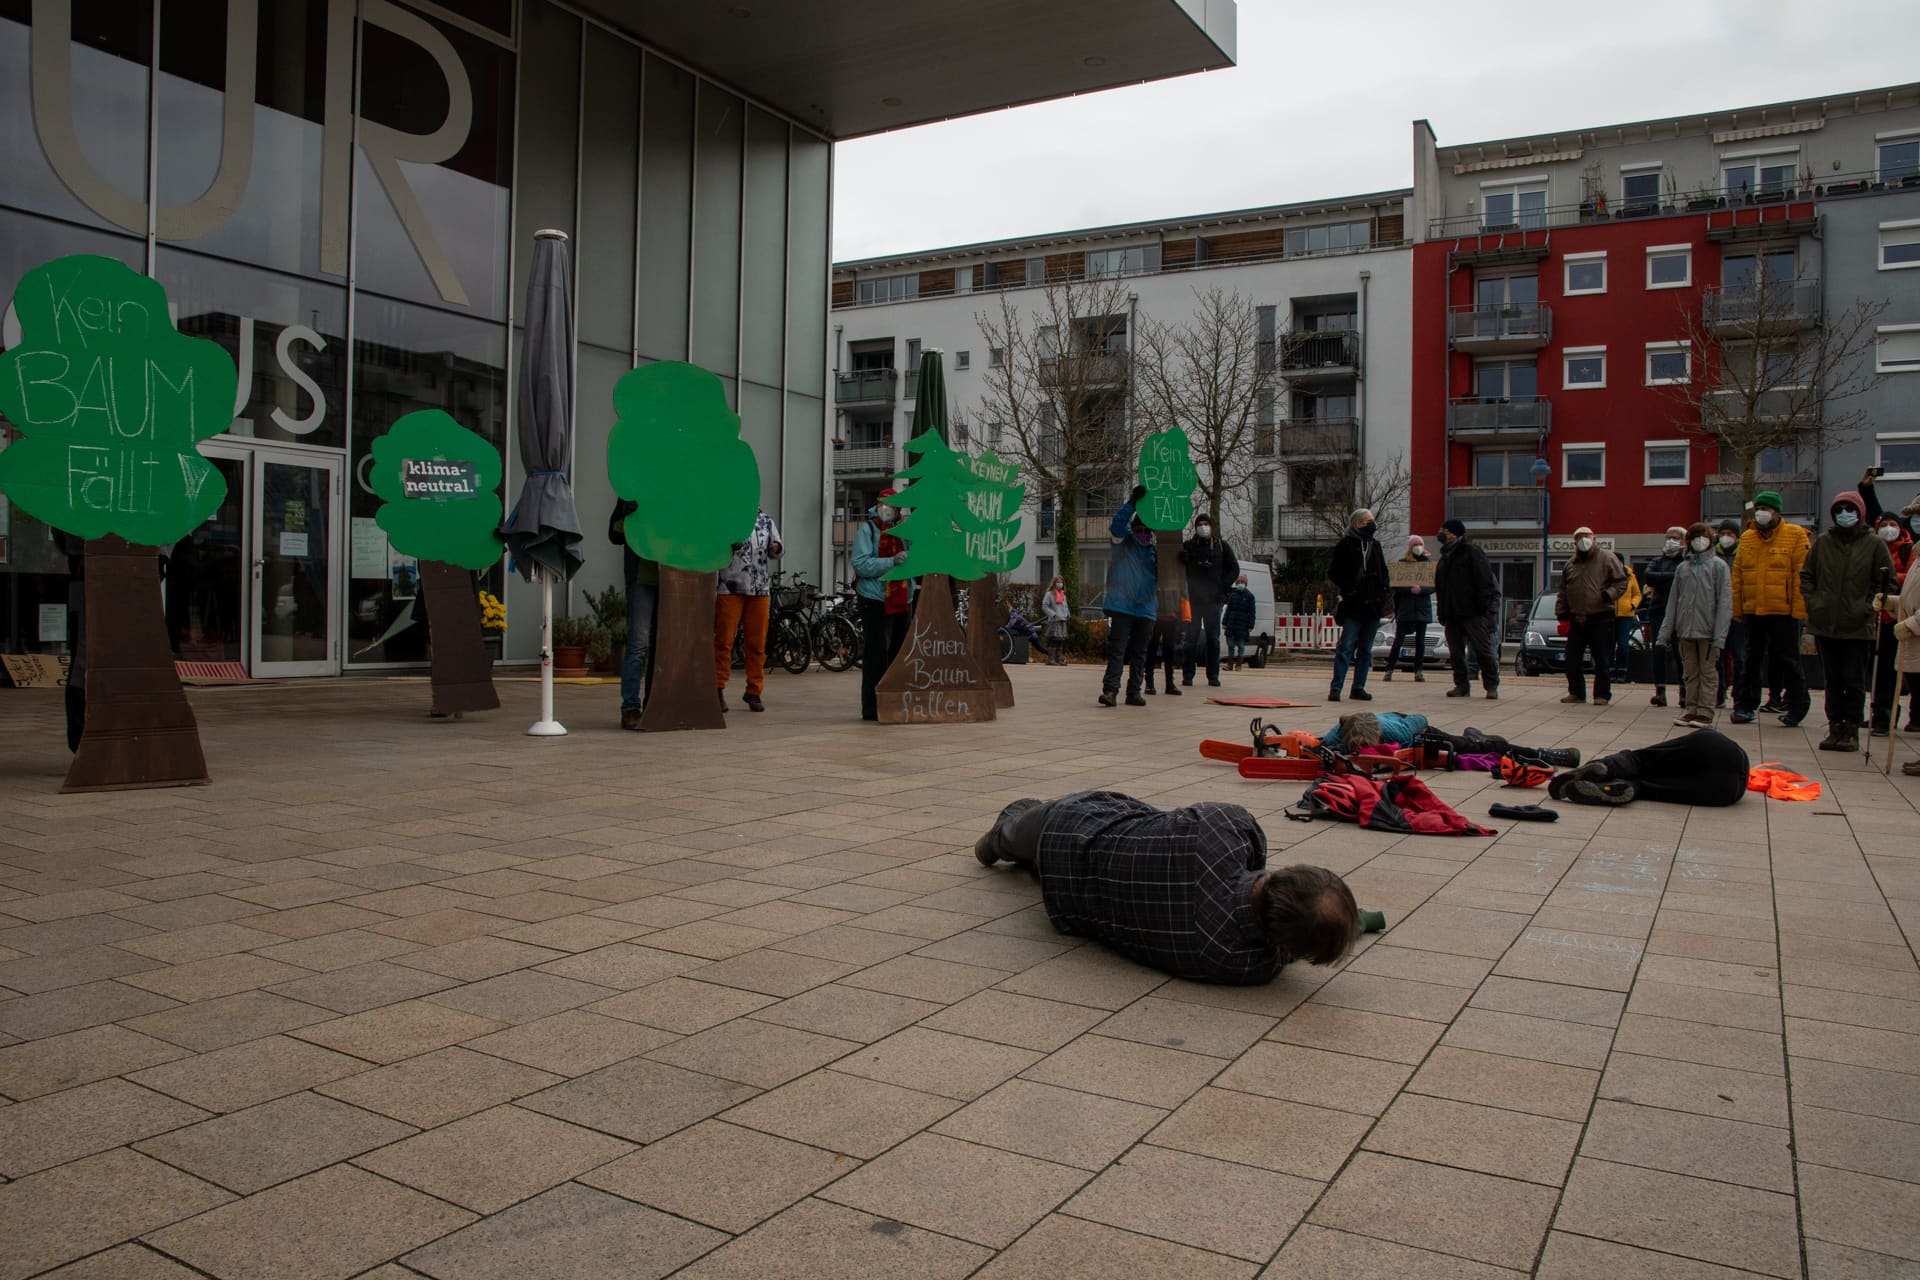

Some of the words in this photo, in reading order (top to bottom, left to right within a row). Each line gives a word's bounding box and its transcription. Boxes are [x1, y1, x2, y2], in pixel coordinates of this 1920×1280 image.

[46, 270, 149, 349] Kein
[15, 350, 195, 448] BAUM
[1153, 436, 1182, 462] Kein
[407, 461, 467, 476] klima-
[970, 458, 1009, 483] KEINEN
[1143, 465, 1195, 491] BAUM
[406, 479, 474, 493] neutral.
[967, 490, 1004, 521] BAUM
[904, 615, 967, 662] Keinen
[904, 658, 977, 690] Baum
[901, 689, 973, 723] fällen
